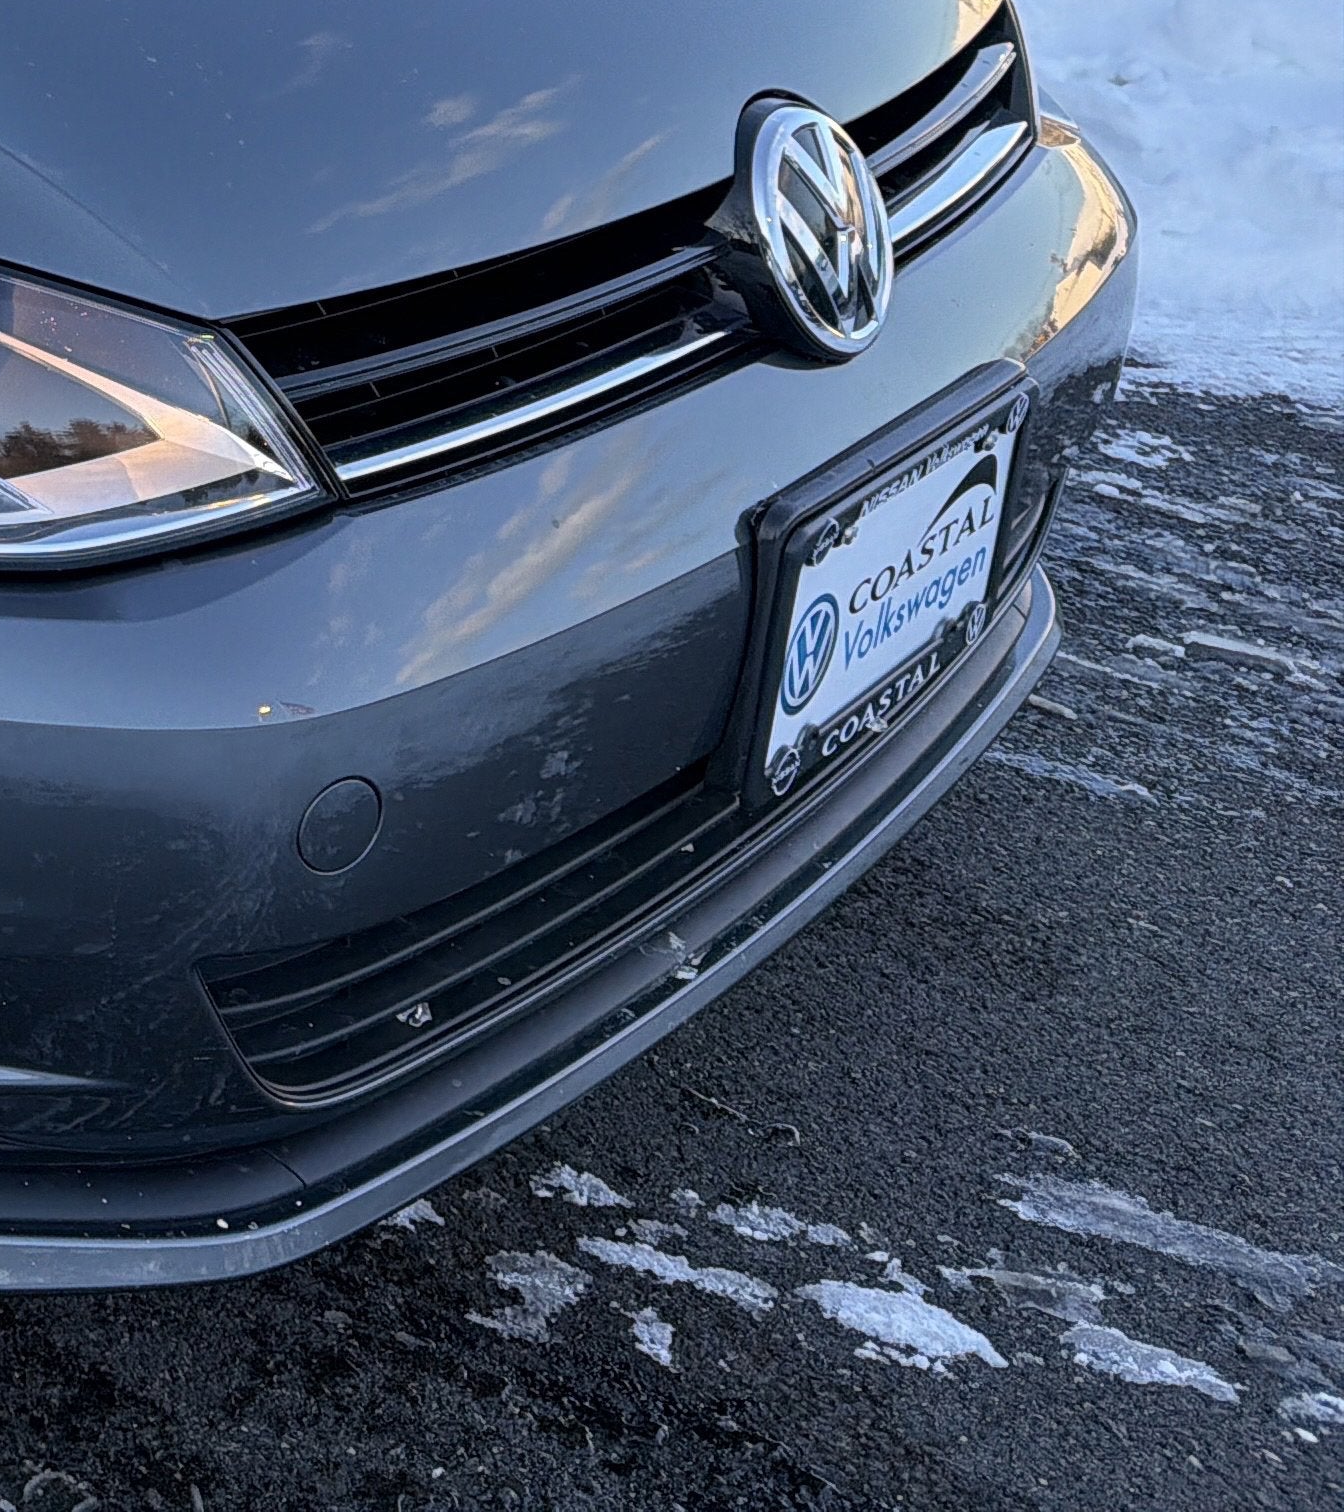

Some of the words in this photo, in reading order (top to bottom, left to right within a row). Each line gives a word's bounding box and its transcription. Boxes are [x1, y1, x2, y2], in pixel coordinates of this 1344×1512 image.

[844, 546, 987, 671] Volkswagen
[849, 493, 995, 615] COASTAL
[821, 652, 941, 758] COASTAL
